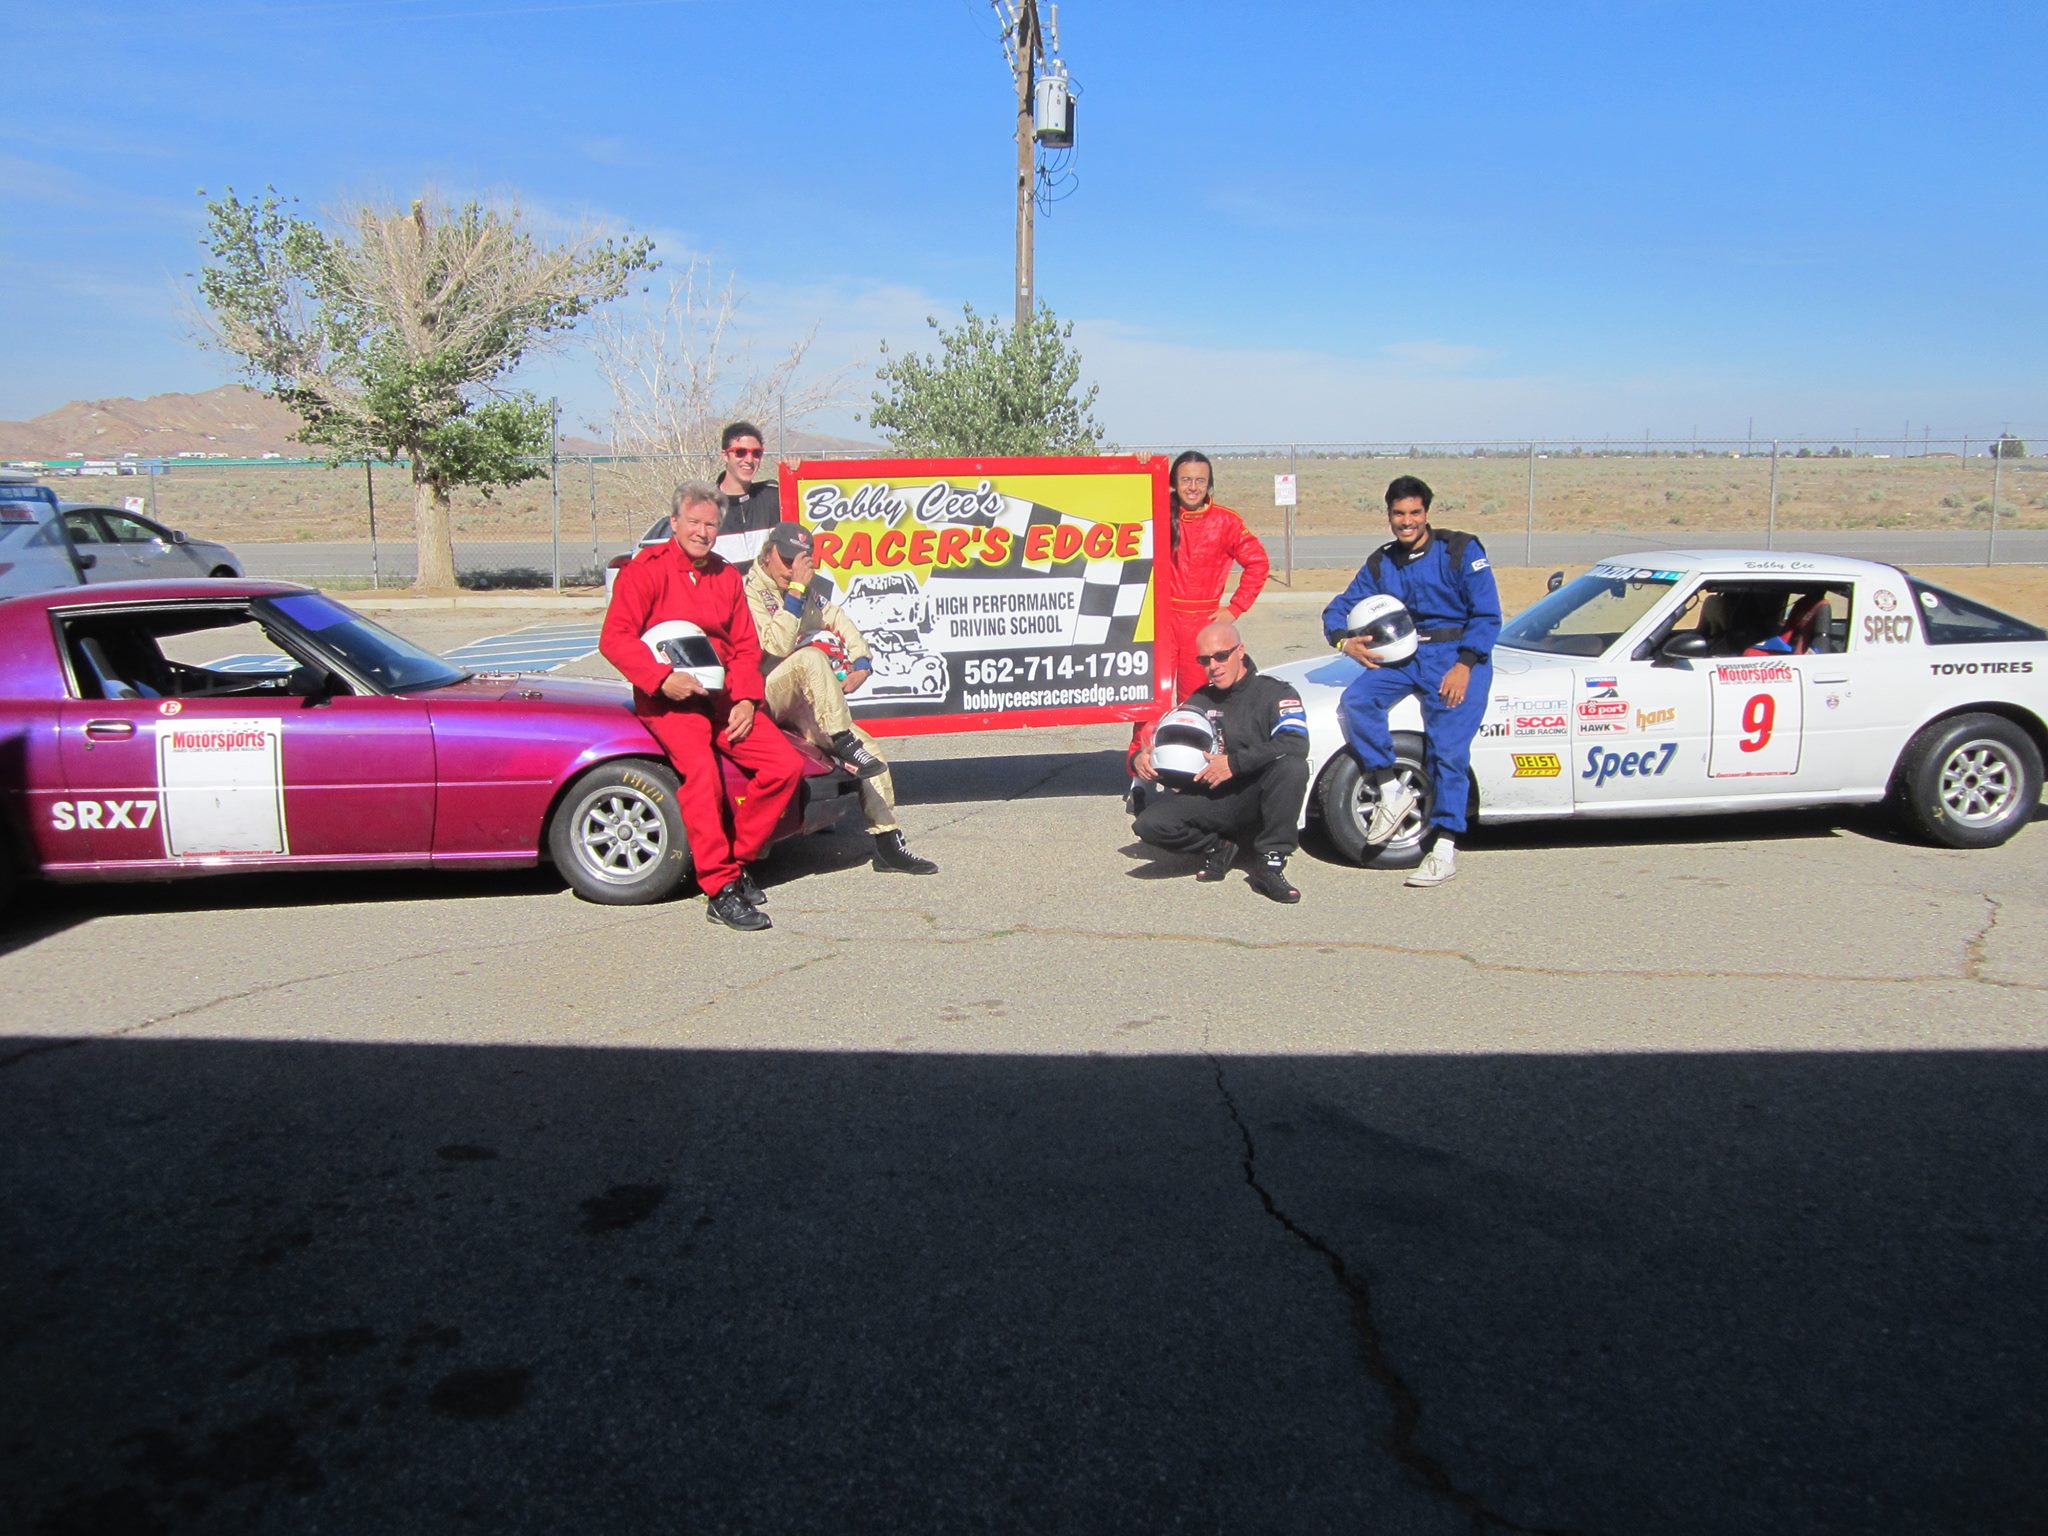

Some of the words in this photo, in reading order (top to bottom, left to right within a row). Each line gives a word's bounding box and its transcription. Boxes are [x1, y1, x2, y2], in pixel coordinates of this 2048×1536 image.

[805, 483, 904, 524] Bobby
[916, 481, 1004, 520] Cee's
[814, 527, 1010, 570] RACER'S
[1026, 522, 1143, 561] EDGE
[1744, 561, 1784, 570] Bobby
[1791, 561, 1816, 570] Cee
[936, 597, 970, 616] HIGH
[973, 592, 1075, 614] PERFORMANCE
[950, 617, 1007, 638] DRIVING
[1011, 615, 1063, 635] SCHOOL
[1864, 615, 1914, 643] SPEC7
[964, 650, 1149, 686] 562-714-1799
[1717, 666, 1793, 683] Motorsports
[1930, 663, 1979, 675] TOYO
[1981, 661, 2034, 674] TIRES
[963, 682, 1149, 712] bobbyceesracersedge.com
[1516, 716, 1566, 728] SCCA
[1580, 724, 1611, 732] HAWK
[1636, 707, 1676, 728] hans
[1740, 693, 1775, 753] 9
[173, 731, 265, 751] Motorsports
[1516, 756, 1556, 767] DEIST
[1582, 743, 1678, 788] Spec7
[52, 800, 157, 830] SRX7
